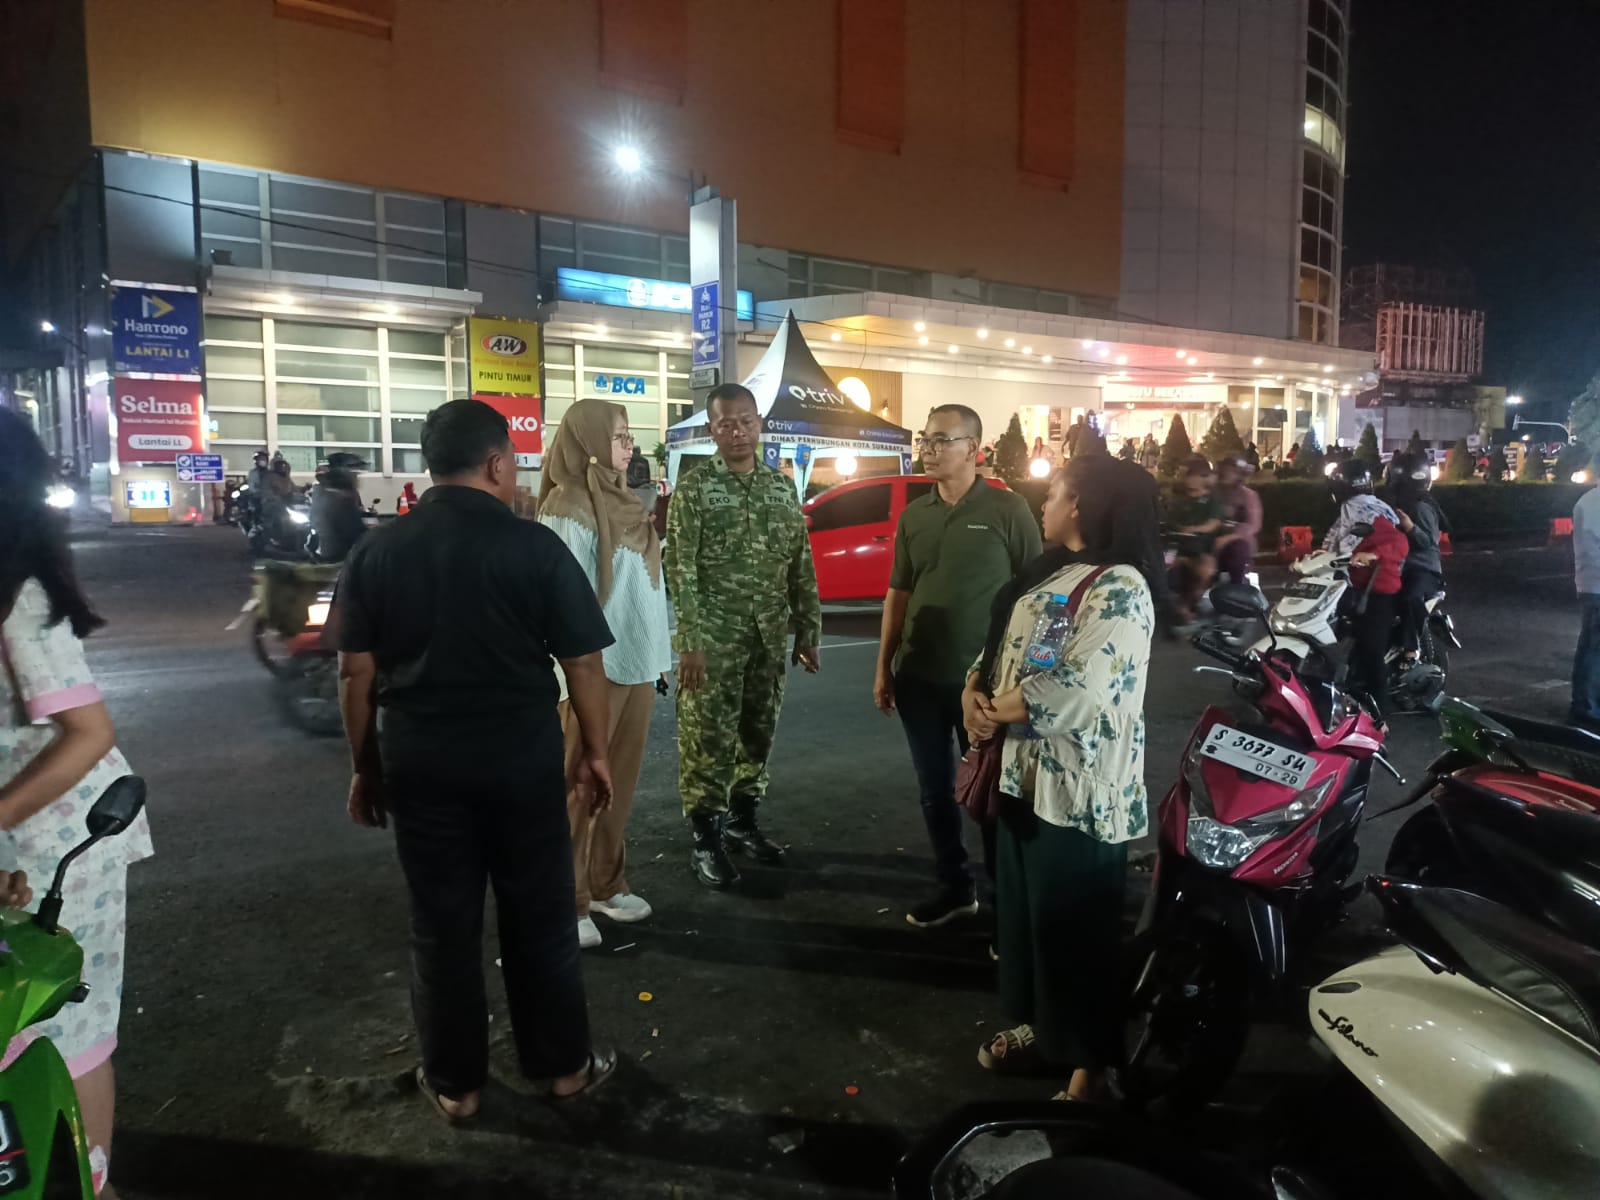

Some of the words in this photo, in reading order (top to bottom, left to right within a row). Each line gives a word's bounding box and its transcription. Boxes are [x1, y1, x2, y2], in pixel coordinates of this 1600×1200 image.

[125, 345, 173, 358] LANTAI
[176, 348, 190, 359] L1
[479, 370, 504, 381] PINTU
[506, 373, 532, 382] TIMUR
[611, 376, 646, 394] BCA
[120, 395, 193, 415] Selma
[138, 437, 171, 447] Lantai
[709, 496, 730, 505] EKO
[1214, 729, 1229, 741] S
[1232, 736, 1276, 758] 3677
